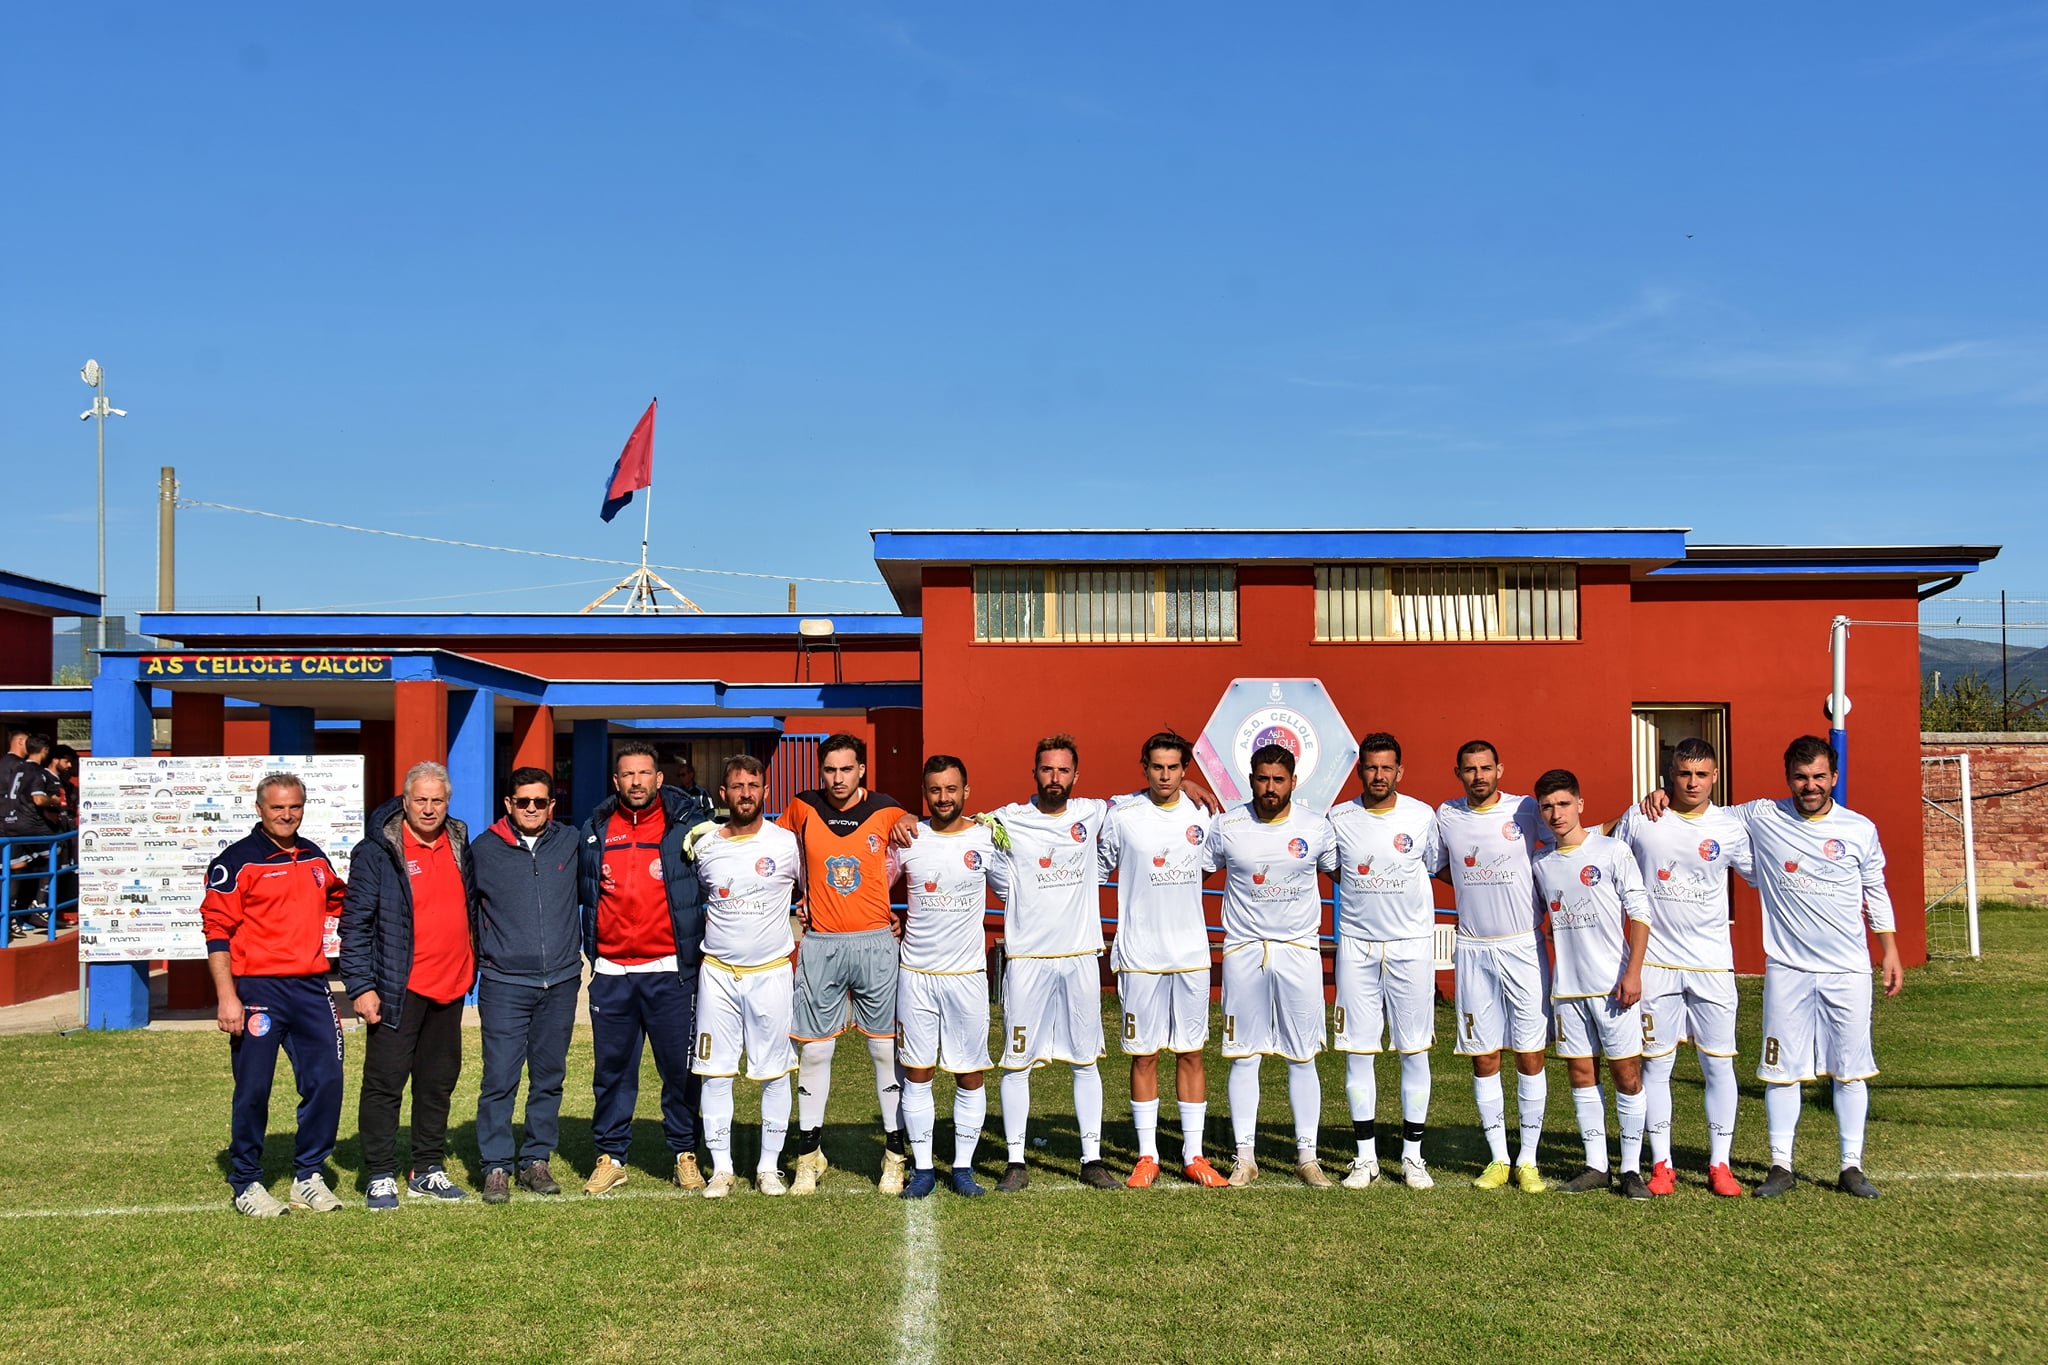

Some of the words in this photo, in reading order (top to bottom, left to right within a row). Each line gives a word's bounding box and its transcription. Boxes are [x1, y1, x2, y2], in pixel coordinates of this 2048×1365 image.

[195, 656, 293, 675] CELLOLE
[301, 656, 384, 674] CALCIO
[1240, 720, 1264, 750] A.S.D.
[1270, 712, 1314, 750] CELLOLE
[828, 819, 859, 827] GIVOVA
[1125, 1012, 1136, 1039] 6
[1223, 1014, 1235, 1041] 4
[1334, 1006, 1345, 1033] 9
[1642, 1013, 1656, 1041] 2
[335, 1029, 343, 1061] CALCIO
[1013, 1026, 1026, 1053] 5
[1765, 1037, 1779, 1065] 8
